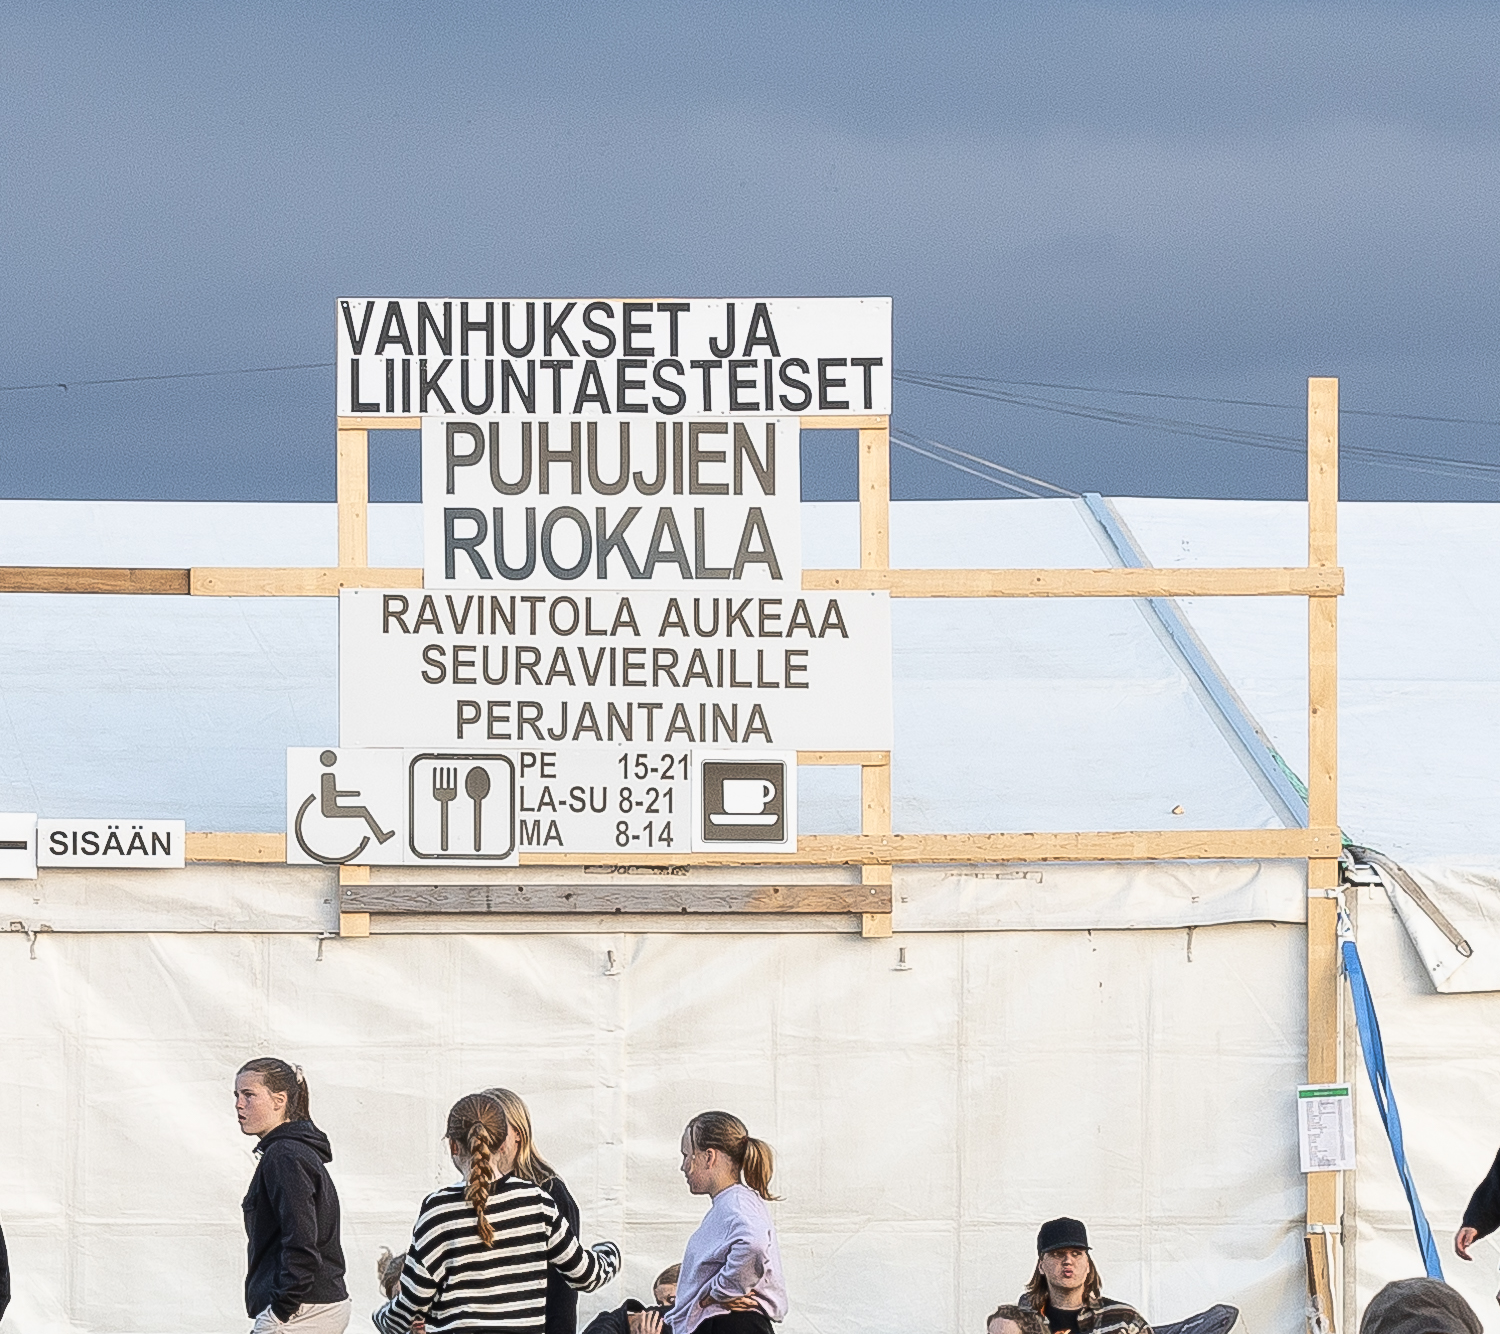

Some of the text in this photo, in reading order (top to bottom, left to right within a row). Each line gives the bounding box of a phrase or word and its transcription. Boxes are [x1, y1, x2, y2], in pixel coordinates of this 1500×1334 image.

[340, 300, 782, 358] VANHUKSET JA
[350, 357, 884, 415] LIIKUNTAESTEISET
[445, 421, 776, 496] PUHUJIEN
[443, 505, 784, 581] RUOKALA
[382, 594, 849, 639] RAVINTOLA AUKEAA
[421, 643, 810, 689] SEURAVIERAILLE
[456, 699, 774, 743] PERJANTAINA
[520, 751, 690, 781] PE 15-21
[519, 785, 674, 814] LA-SU 8-21
[48, 825, 171, 856] SISÄÄN
[519, 819, 674, 848] MA 8-14
